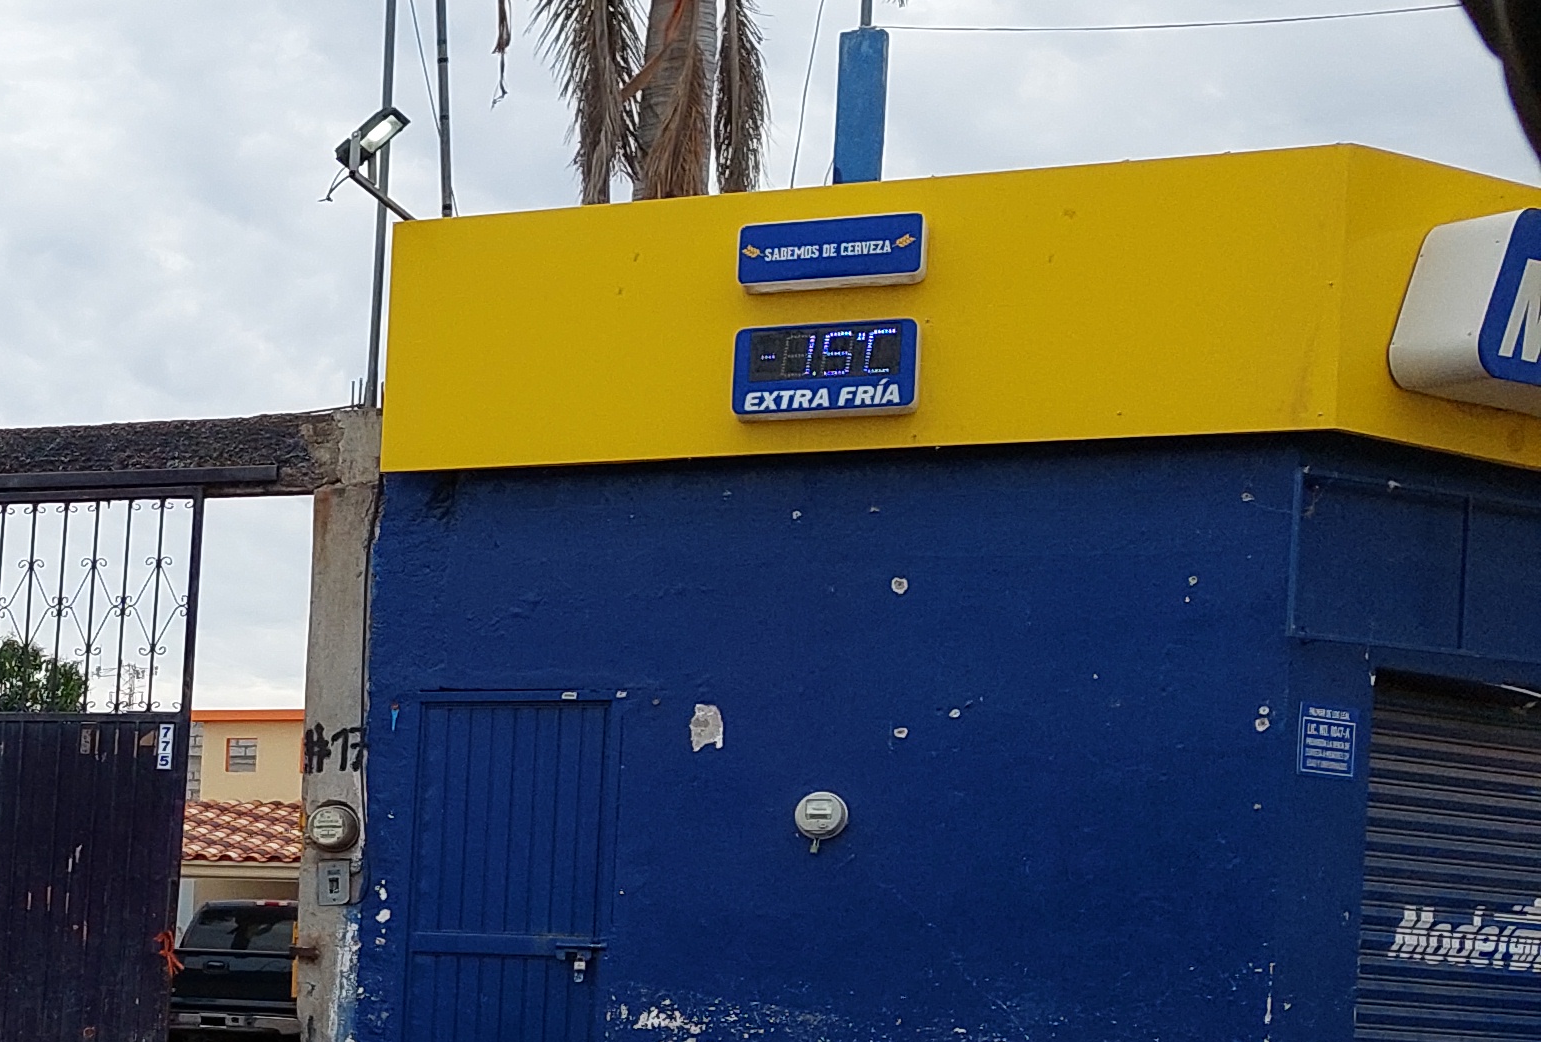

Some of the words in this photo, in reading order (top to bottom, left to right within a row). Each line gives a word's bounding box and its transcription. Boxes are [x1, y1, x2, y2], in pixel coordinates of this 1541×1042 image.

[764, 245, 819, 261] SABEMOS
[822, 243, 837, 257] DE
[840, 239, 892, 256] CERVEZA
[743, 387, 830, 412] EXTRA
[837, 377, 901, 406] FRÍA
